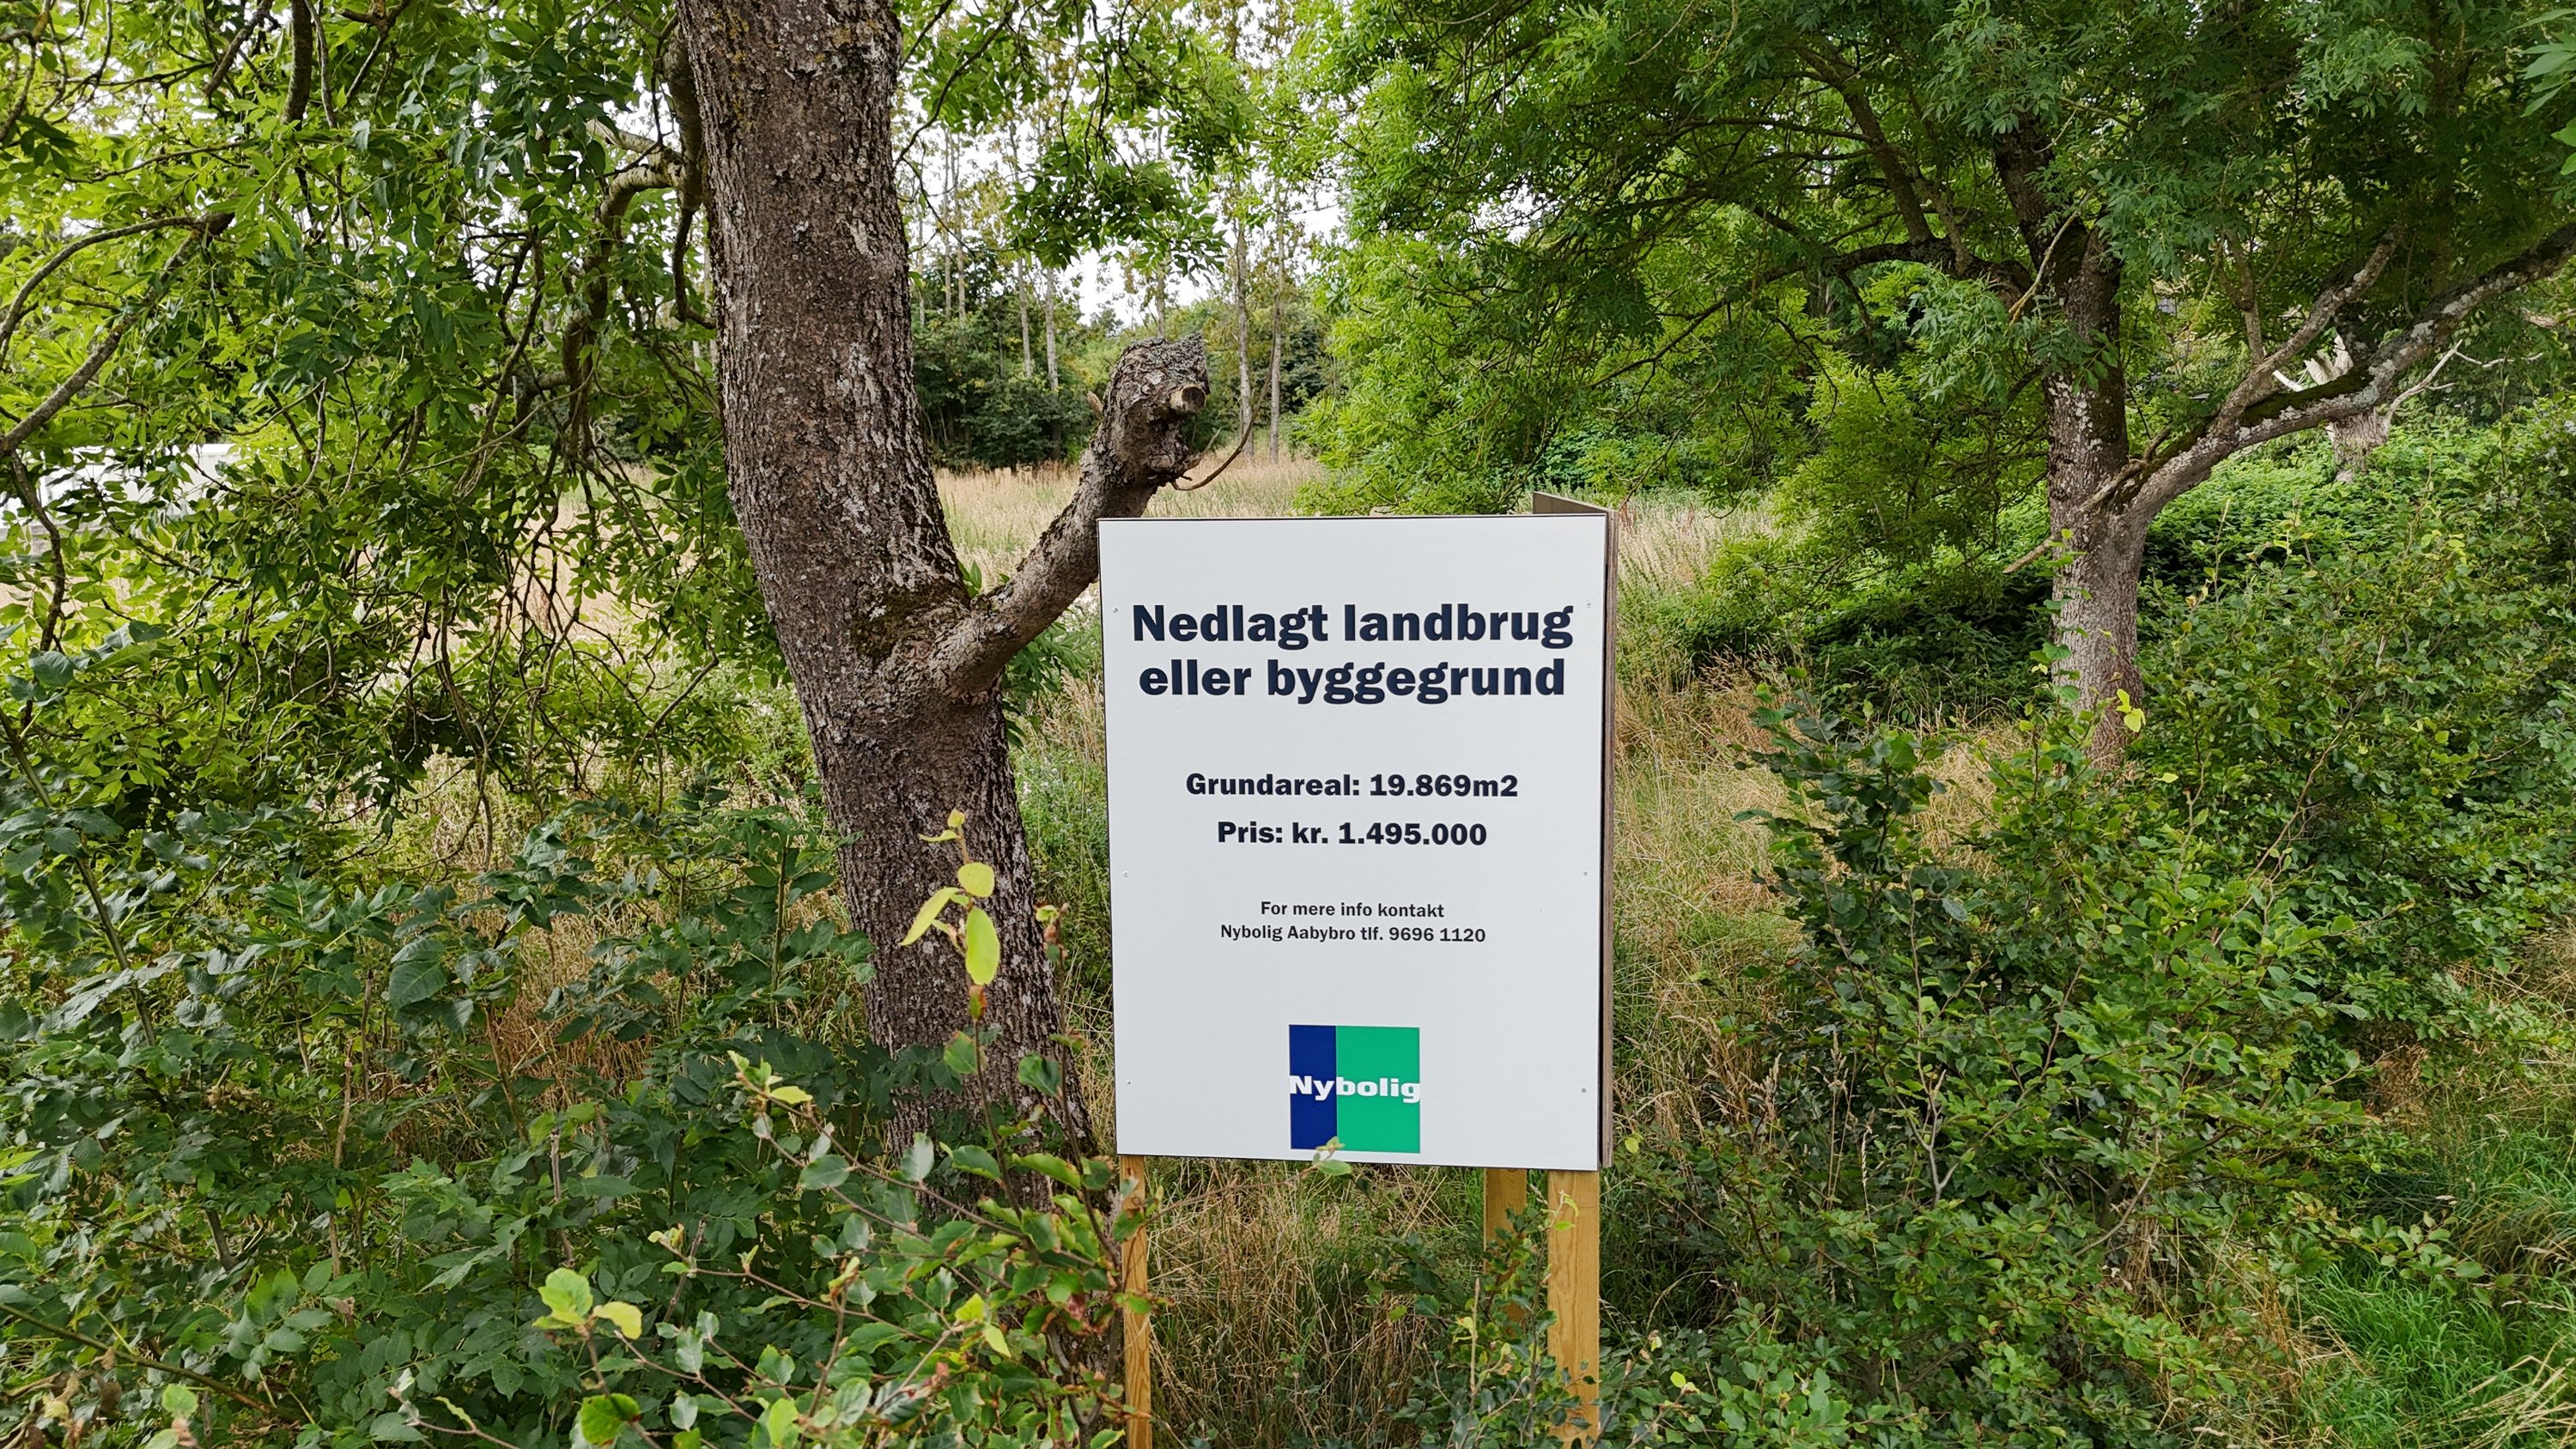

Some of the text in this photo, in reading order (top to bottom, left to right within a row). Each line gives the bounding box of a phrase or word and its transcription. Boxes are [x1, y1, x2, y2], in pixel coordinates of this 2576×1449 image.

[1133, 603, 1574, 651] Nedlagt landbrug
[1139, 658, 1564, 705] eller byggegrund
[1186, 773, 1518, 797] Grundareal: 19.869m2
[1218, 821, 1487, 846] Pris: kr. 1.495.000
[1261, 900, 1444, 918] For mere info kontakt
[1221, 924, 1486, 943] Nybolig Aabybro tlf. 9696 1120
[1289, 1075, 1421, 1104] Nybolig
